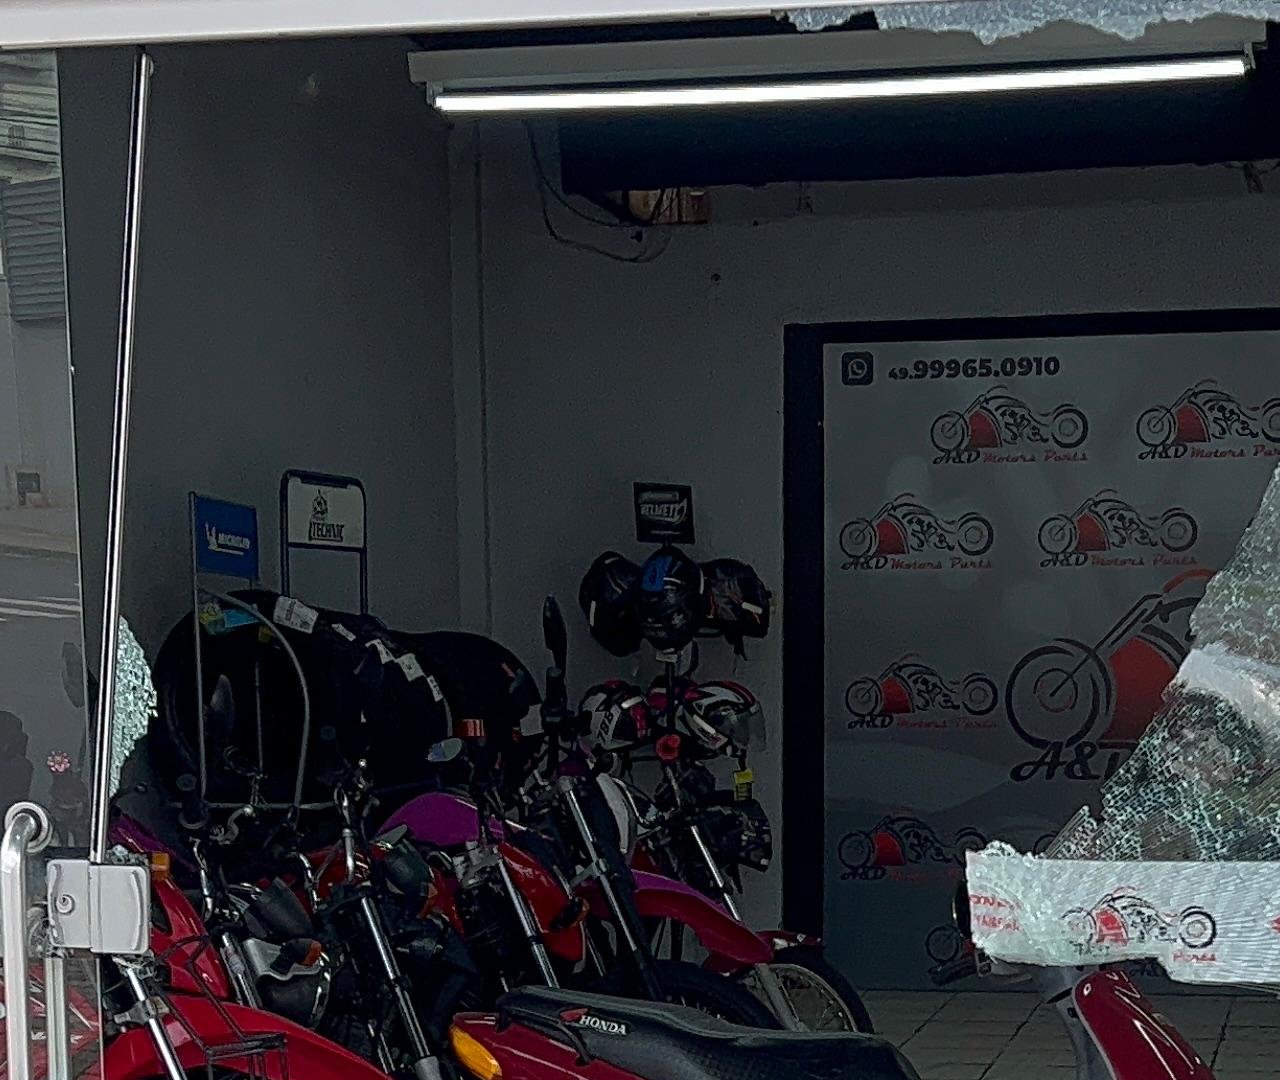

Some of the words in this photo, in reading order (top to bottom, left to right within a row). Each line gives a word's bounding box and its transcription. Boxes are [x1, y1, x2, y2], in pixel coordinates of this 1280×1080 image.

[932, 447, 978, 464] A&D
[982, 451, 1036, 463] Motors
[1043, 449, 1088, 462] Parts
[1138, 442, 1187, 460] A&D
[1189, 446, 1246, 459] Motors
[840, 556, 886, 571] A&D
[1040, 552, 1087, 568] A&D
[579, 1014, 627, 1036] HONDA
